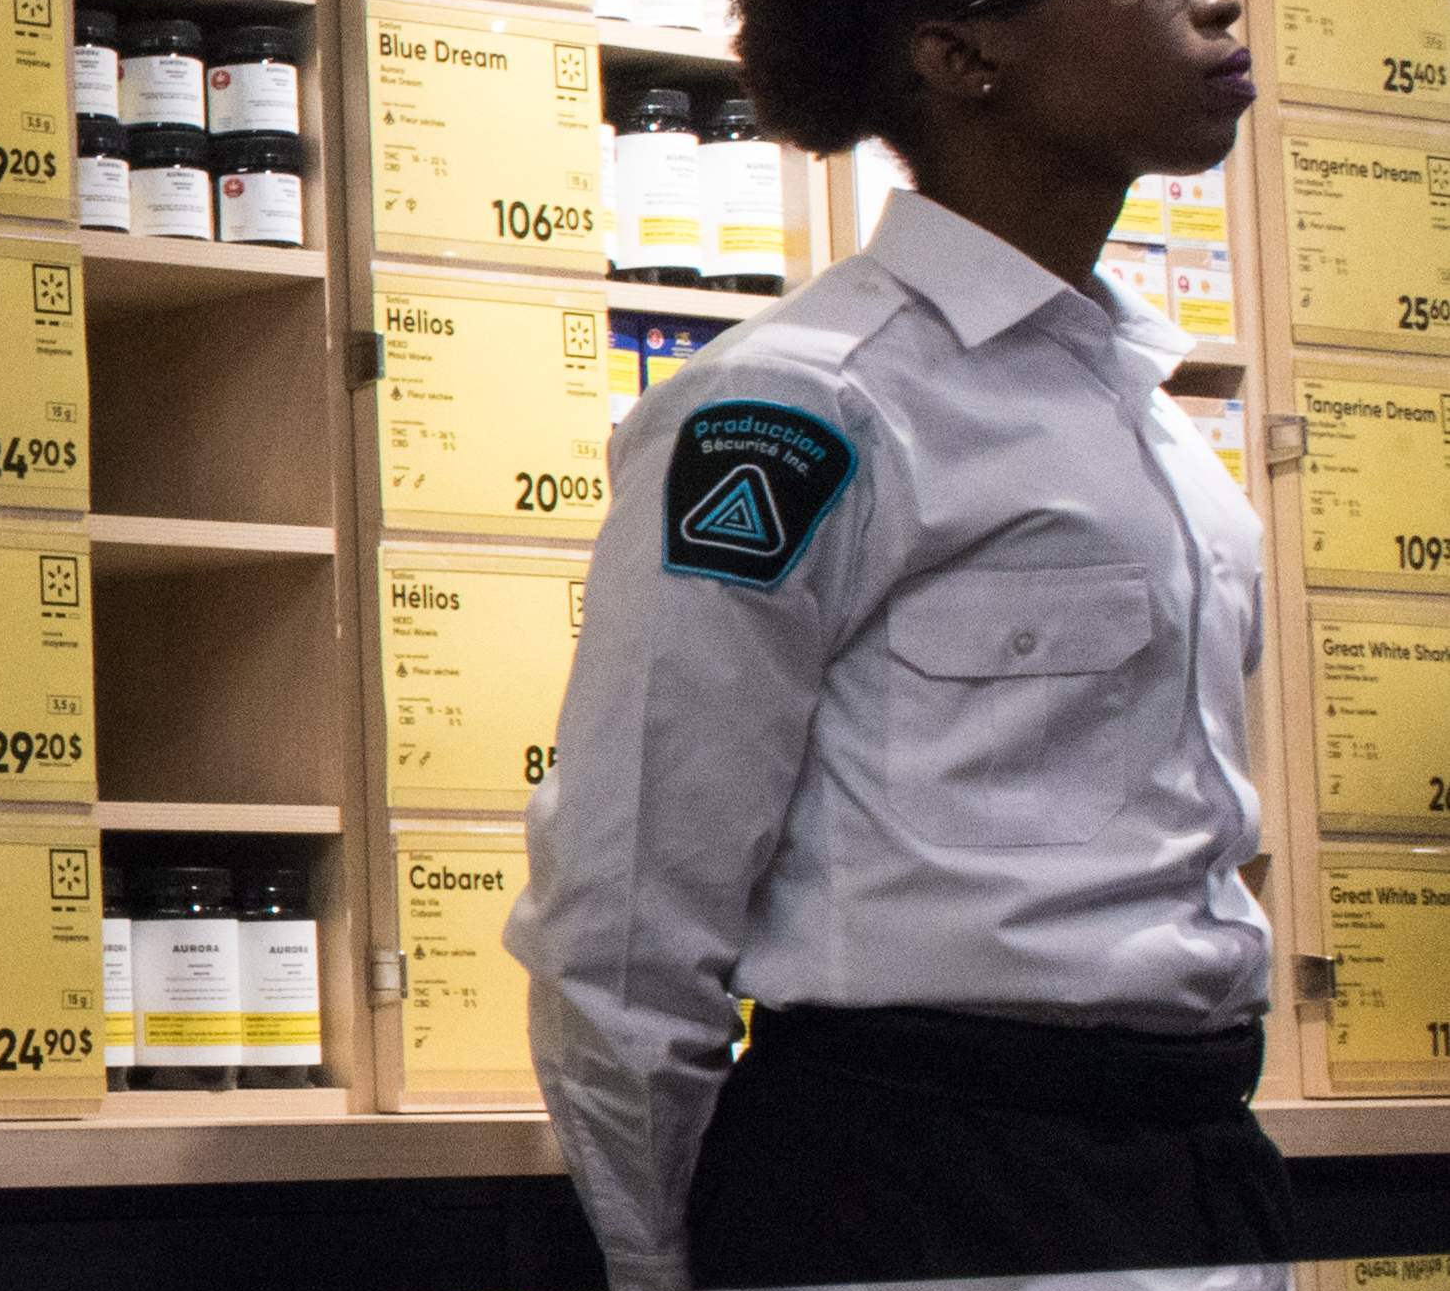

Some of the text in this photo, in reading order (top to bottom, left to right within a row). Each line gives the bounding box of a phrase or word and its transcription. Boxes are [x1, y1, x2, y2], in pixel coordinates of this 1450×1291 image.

[379, 33, 508, 71] Blue Dream
[1291, 152, 1422, 183] Tangerine Dream
[387, 308, 455, 336] Hélios
[1304, 393, 1436, 423] Tangerine Dream
[392, 583, 460, 610] Hélios
[1323, 639, 1366, 659] Great
[1370, 642, 1411, 661] White
[409, 866, 504, 891] Cabaret
[1330, 886, 1416, 906] Great White
[172, 945, 219, 953] AURORA
